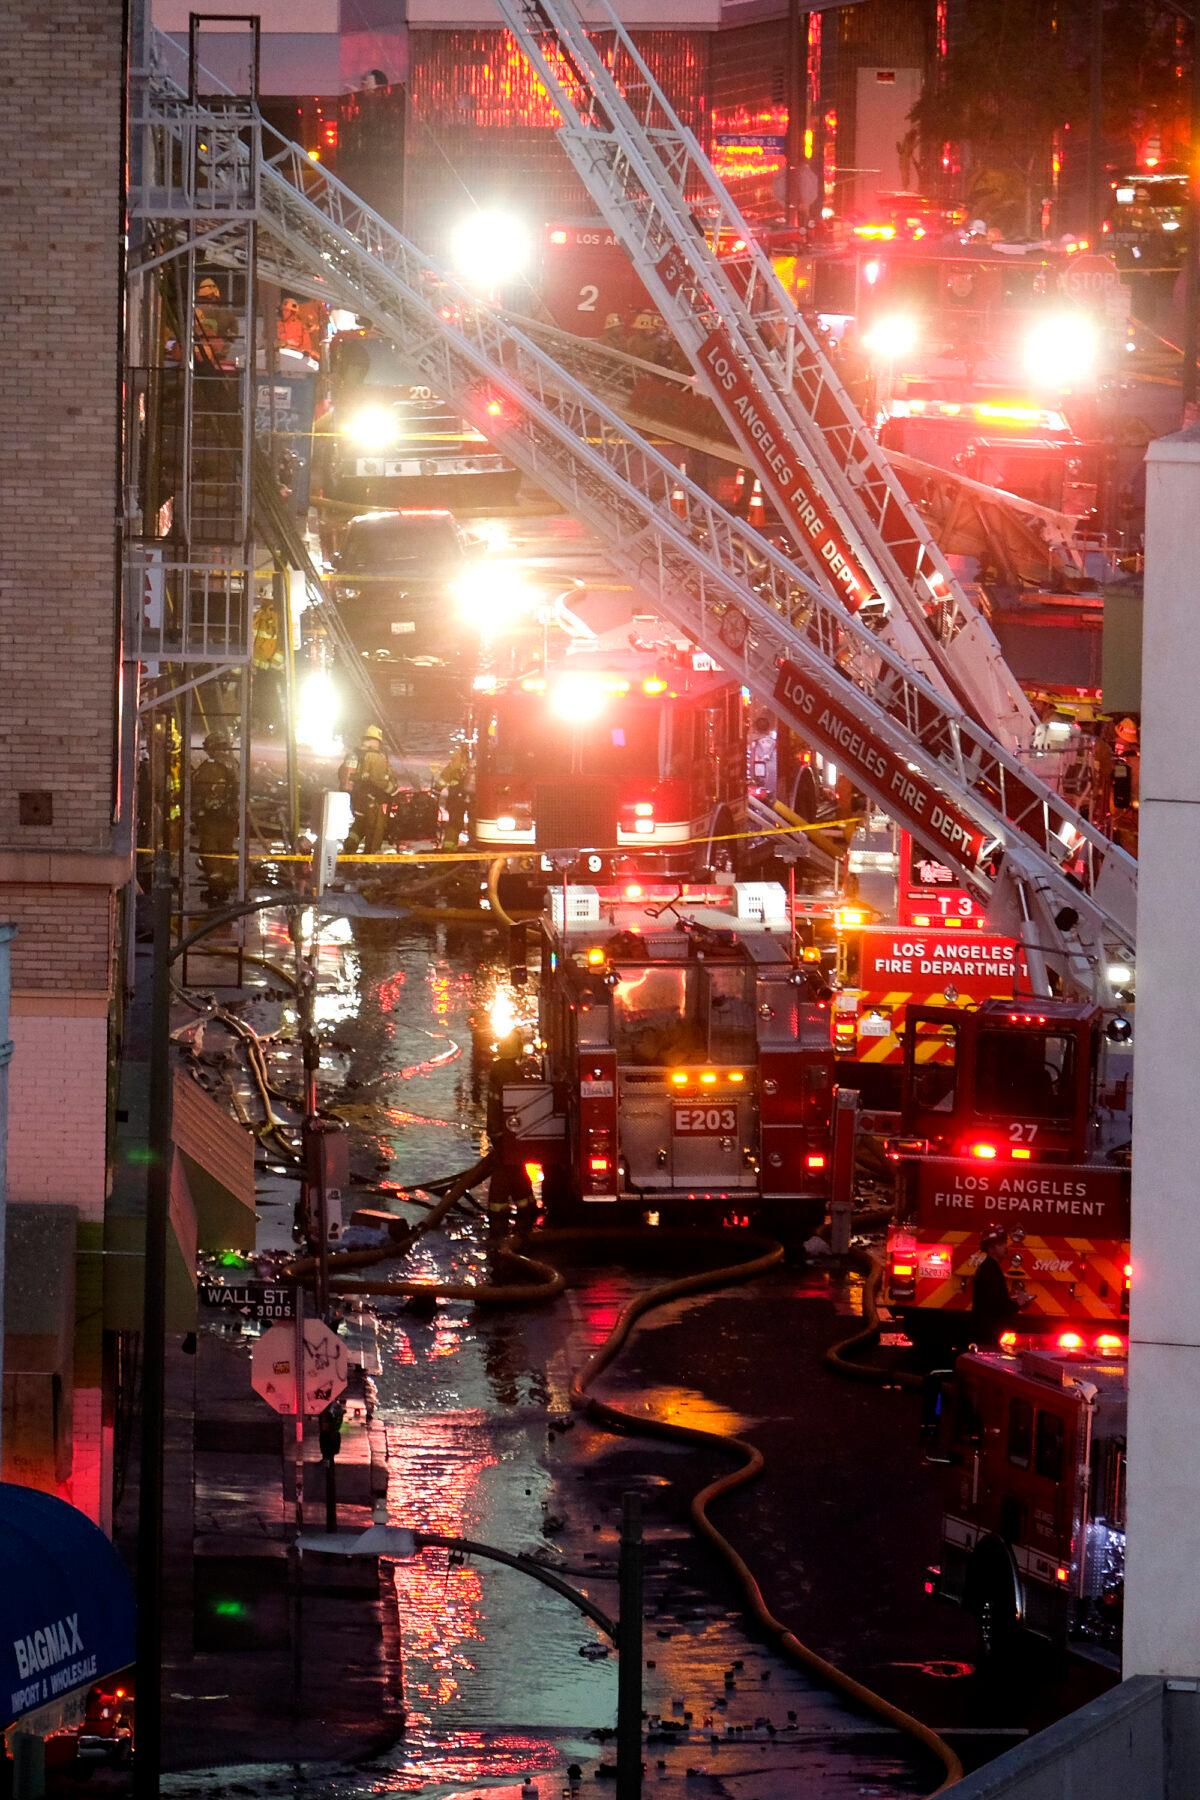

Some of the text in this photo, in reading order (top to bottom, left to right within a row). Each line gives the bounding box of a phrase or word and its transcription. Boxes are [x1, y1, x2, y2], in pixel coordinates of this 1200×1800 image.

[576, 234, 600, 245] LOS
[665, 266, 677, 281] 3
[1071, 272, 1116, 292] STOP
[576, 284, 600, 312] 2
[409, 385, 440, 400] 20
[706, 346, 861, 601] LOS ANGELES FIRE DEPT.
[783, 676, 973, 857] LOS ANGELES FIRE DEPT.
[588, 855, 602, 873] 9
[937, 897, 973, 915] T 3
[893, 943, 1014, 960] LOS ANGELES
[875, 959, 912, 974] FIRE
[675, 1109, 736, 1131] E203
[1009, 1123, 1039, 1142] 27
[955, 1175, 1087, 1197] LOS ANGELES
[935, 1193, 1106, 1217] FIRE DEPARTMENT
[1032, 1259, 1074, 1272] SHOW
[207, 1289, 291, 1304] WALL ST.
[13, 1612, 85, 1680] BAGMAX
[11, 1681, 41, 1714] IMPORT
[42, 1678, 49, 1700] &
[51, 1654, 98, 1694] WHOLESALE
